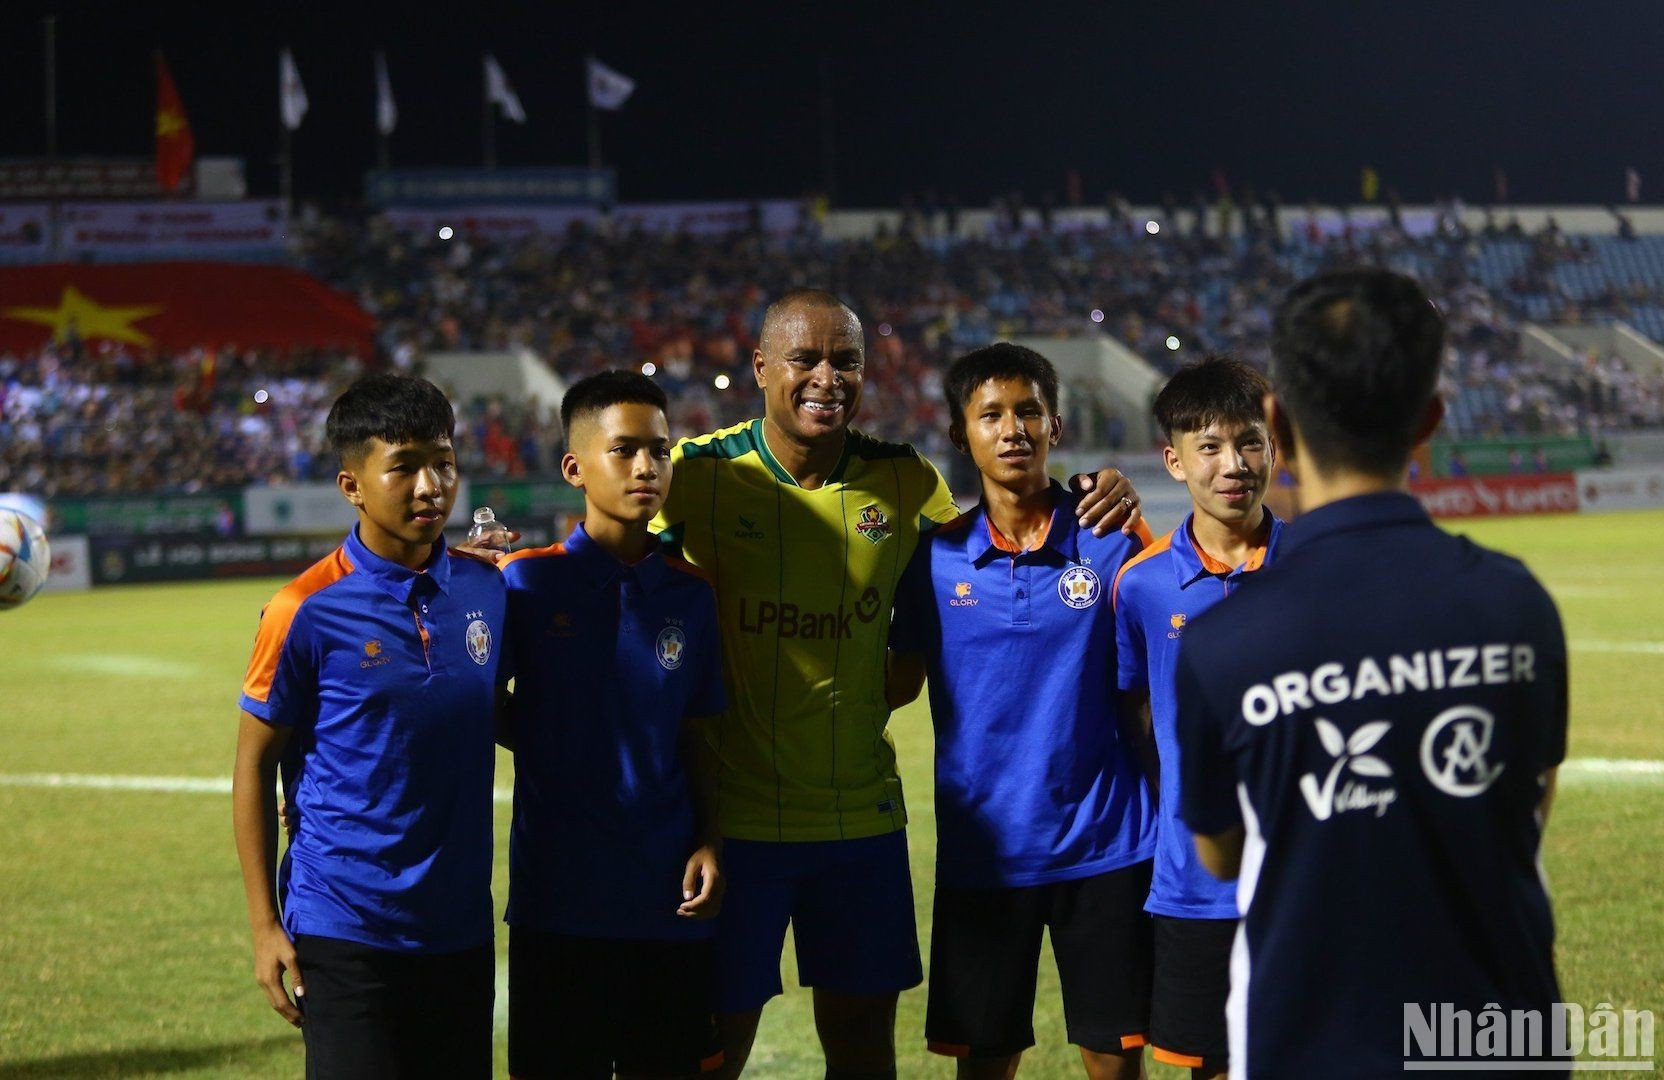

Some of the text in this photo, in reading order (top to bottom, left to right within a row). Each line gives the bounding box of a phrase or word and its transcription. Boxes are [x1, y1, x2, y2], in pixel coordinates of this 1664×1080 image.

[950, 599, 979, 607] GLORY
[738, 597, 854, 640] LPBank
[360, 656, 391, 669] GLORY
[1242, 644, 1536, 727] ORGANIZER
